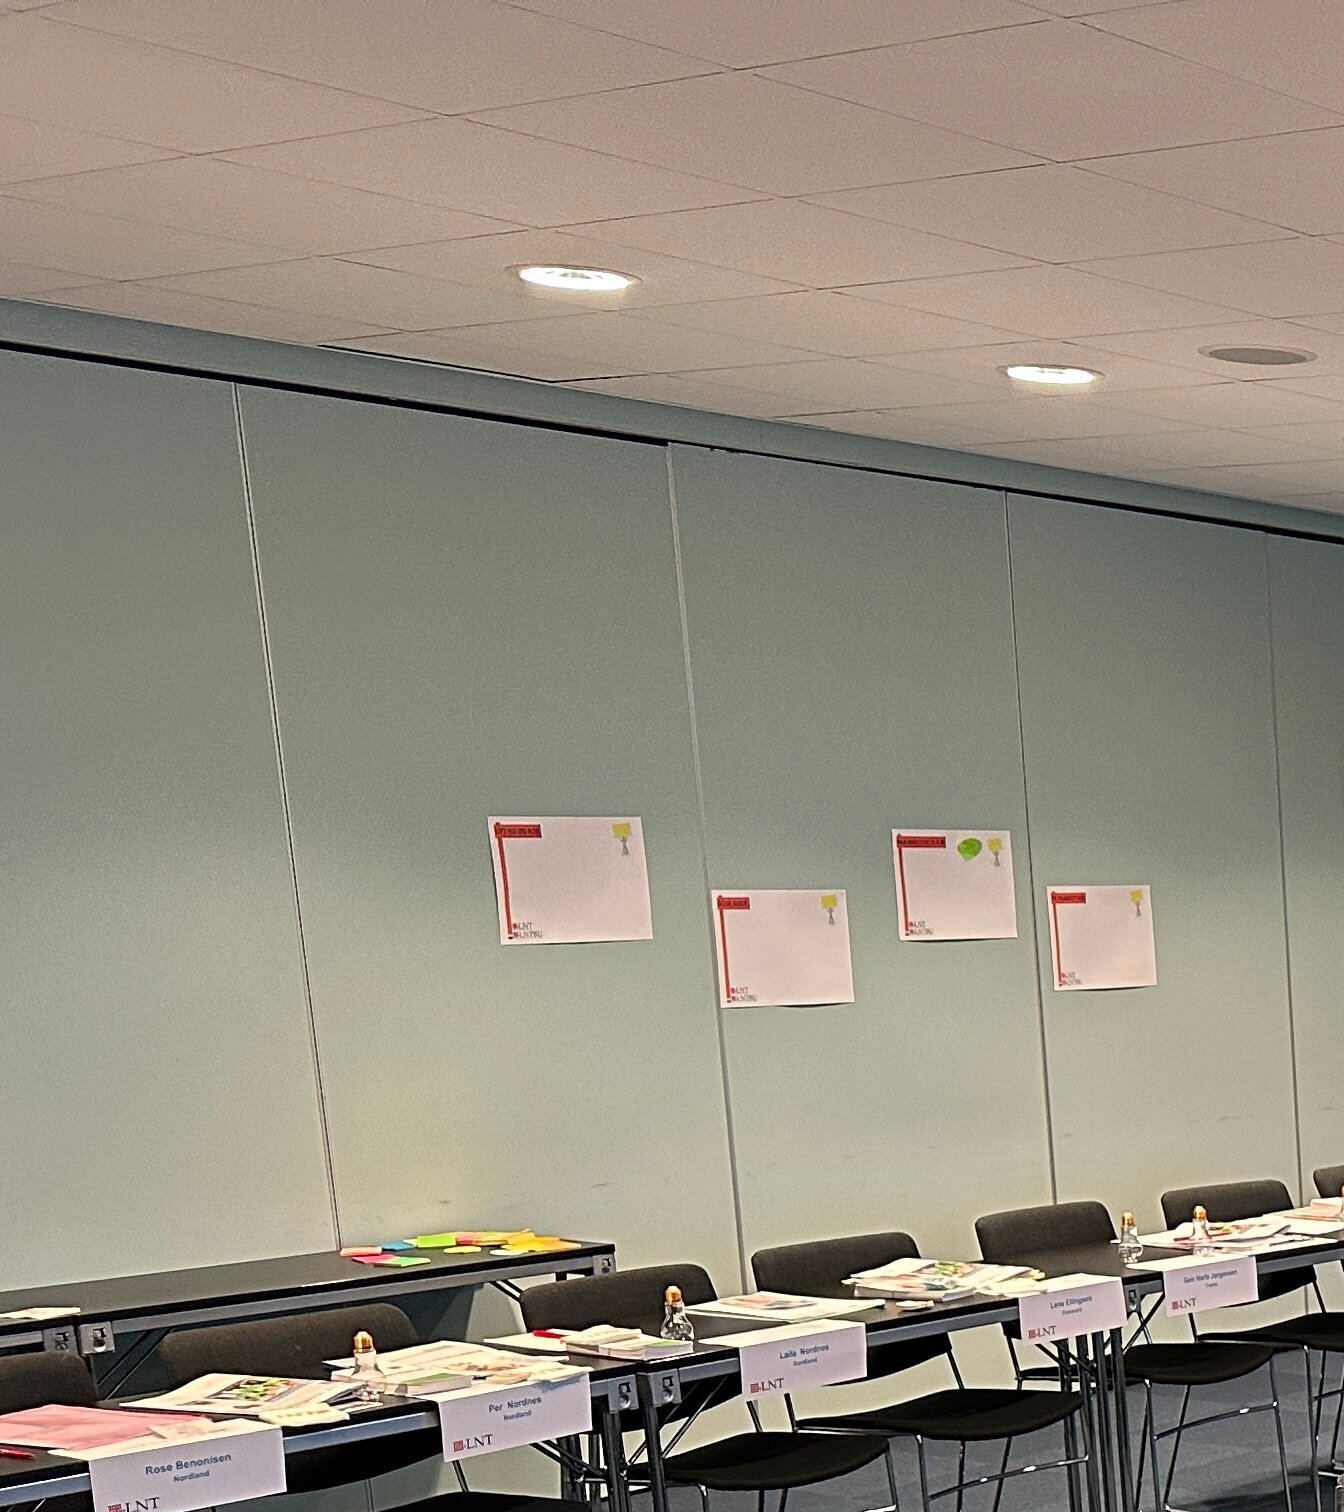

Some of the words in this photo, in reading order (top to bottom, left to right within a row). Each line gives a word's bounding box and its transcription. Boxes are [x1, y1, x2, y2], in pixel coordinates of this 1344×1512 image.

[761, 1377, 784, 1392] LNT
[488, 1403, 503, 1413] Per
[507, 1397, 542, 1409] Nordnes
[465, 1434, 493, 1450] LNT
[145, 1461, 173, 1476] Rose
[176, 1453, 232, 1471] Benonisen
[173, 1469, 210, 1483] Nordland
